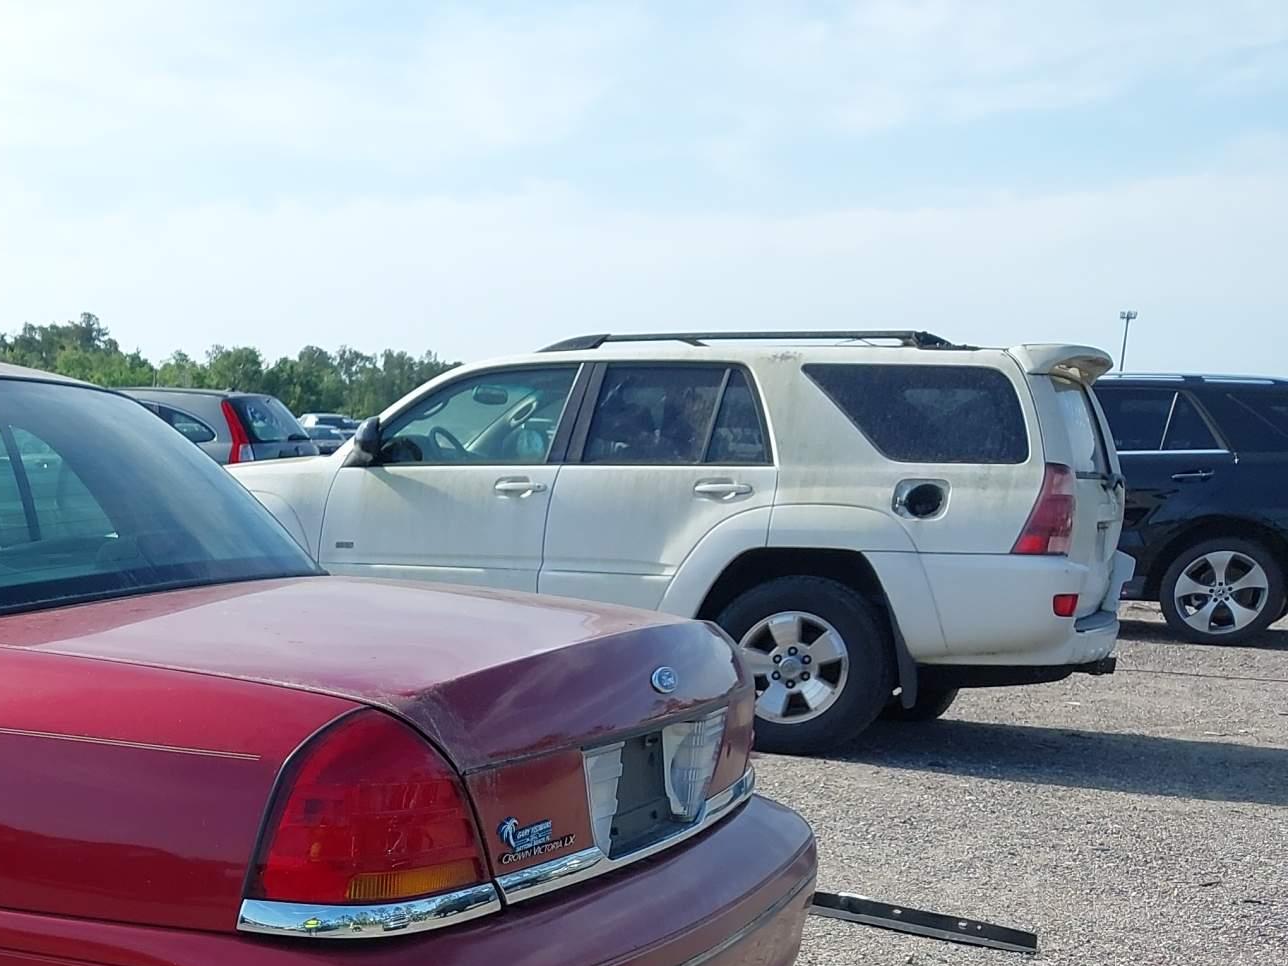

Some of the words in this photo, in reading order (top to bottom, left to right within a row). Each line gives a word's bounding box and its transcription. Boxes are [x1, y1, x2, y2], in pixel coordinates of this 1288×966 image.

[502, 848, 532, 865] CROWN
[533, 839, 563, 855] VICTORIA
[564, 834, 576, 846] LX
